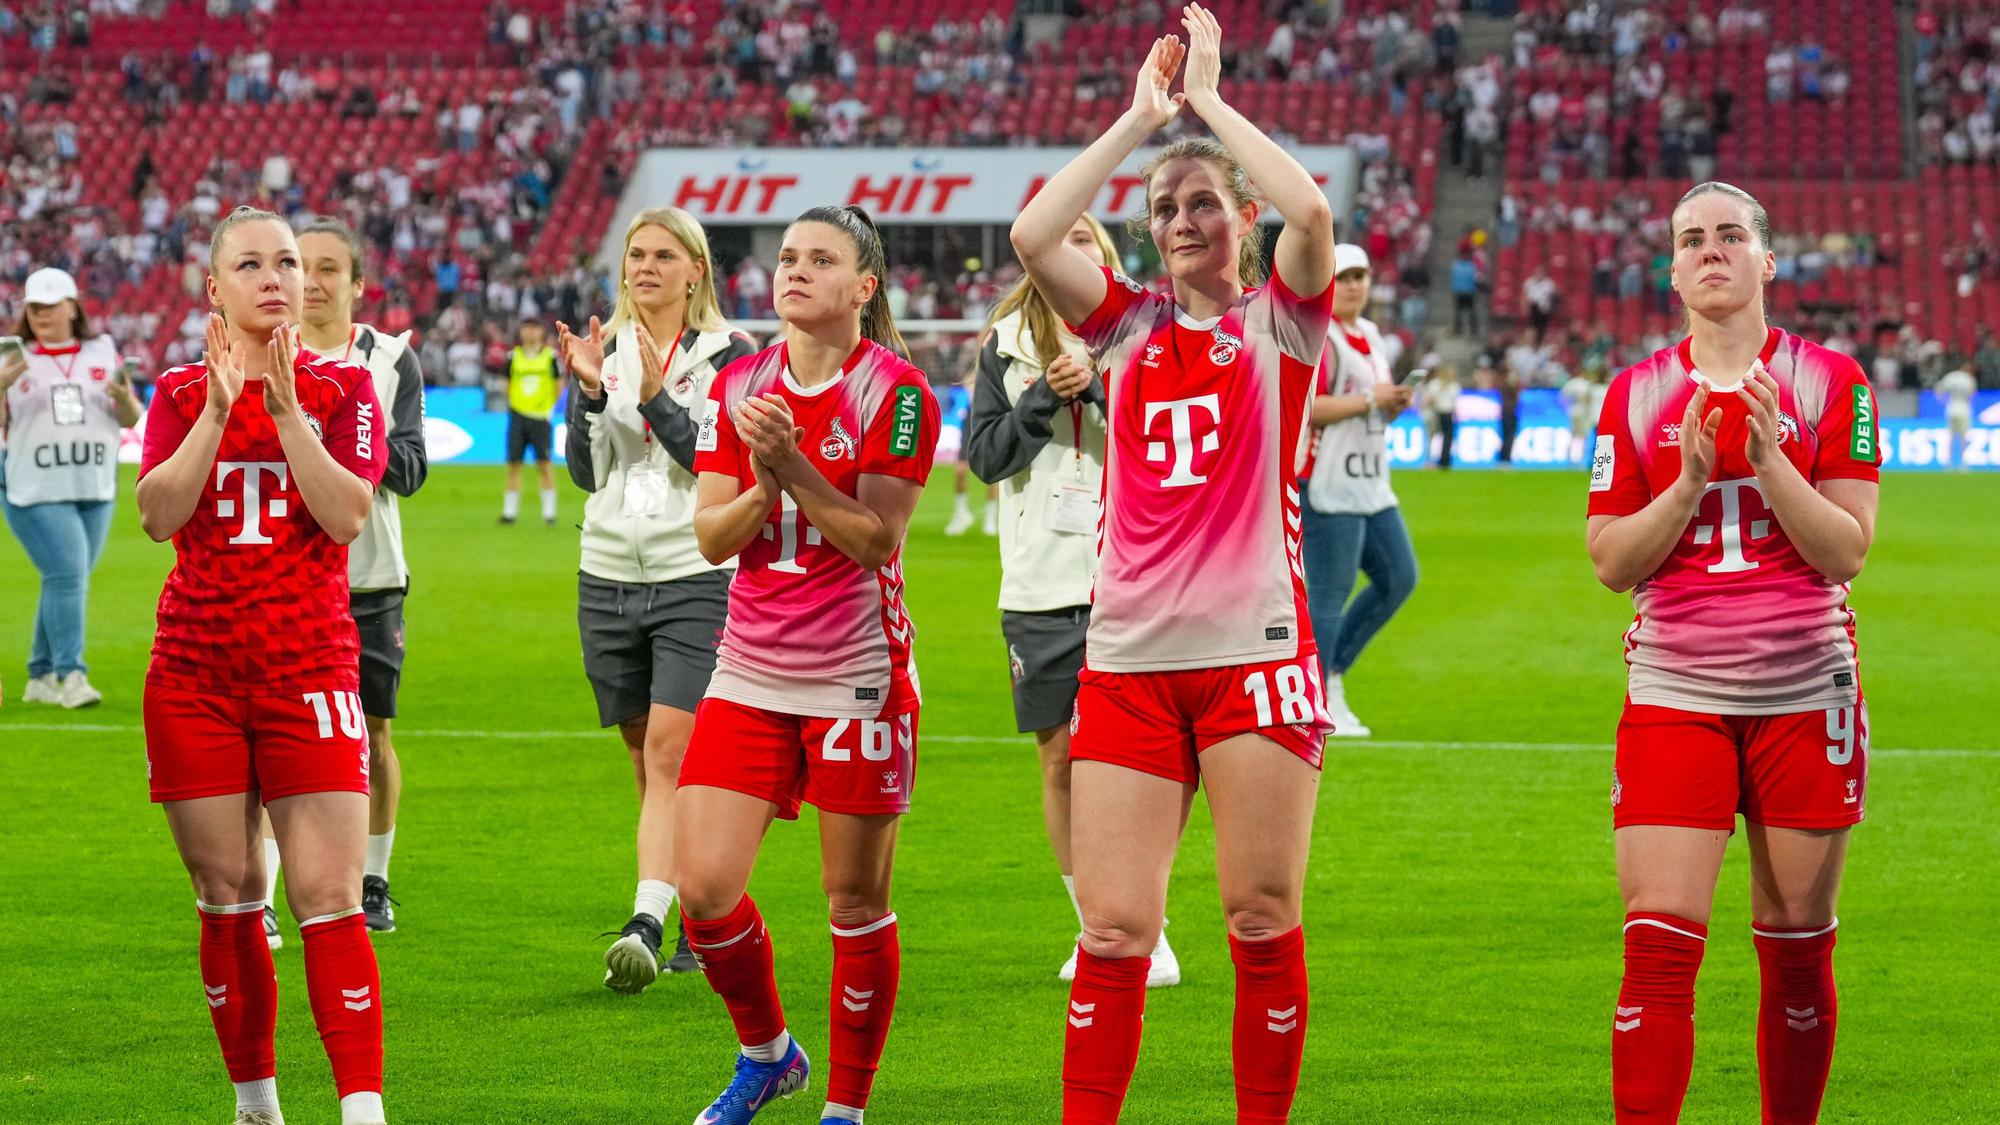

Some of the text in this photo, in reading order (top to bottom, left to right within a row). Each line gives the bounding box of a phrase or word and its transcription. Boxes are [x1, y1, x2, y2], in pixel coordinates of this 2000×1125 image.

[673, 175, 799, 213] HIT
[846, 175, 975, 213] HIT
[356, 401, 373, 460] DEVK
[896, 392, 917, 450] DEVK
[1144, 393, 1221, 488] T
[1856, 392, 1871, 455] DEVK
[34, 442, 106, 469] CLUB
[217, 462, 287, 545] T
[1693, 476, 1771, 573] T
[303, 691, 362, 739] 10
[1243, 665, 1315, 727] 18
[822, 718, 892, 761] 26
[1825, 706, 1855, 765] 9
